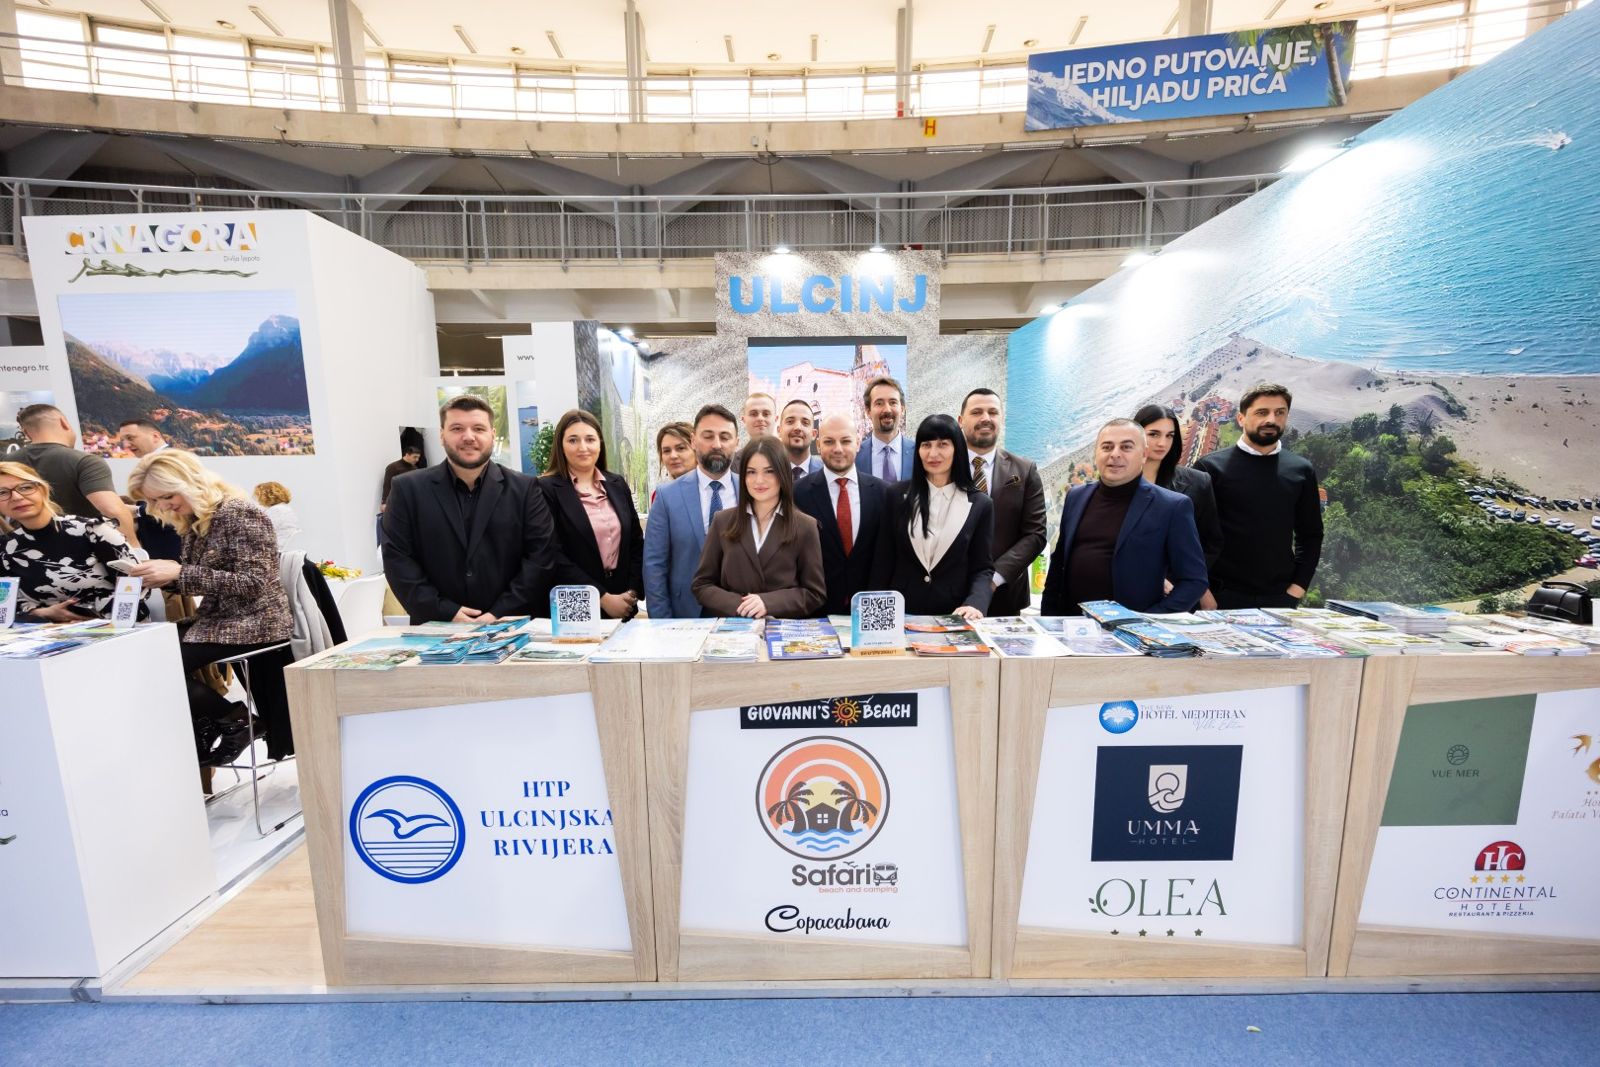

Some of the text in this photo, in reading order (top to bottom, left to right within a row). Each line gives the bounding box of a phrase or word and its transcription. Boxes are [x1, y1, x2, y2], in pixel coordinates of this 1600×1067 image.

[1063, 40, 1317, 86] JEDNO PUTOVANJE,
[1092, 67, 1288, 109] HILJADU PRIČA
[925, 119, 936, 135] H
[729, 274, 928, 314] ULCINJ
[747, 703, 911, 721] GIOVANNI'S BEACH
[1140, 708, 1247, 720] HOTEL MEDITERAN
[1432, 769, 1480, 778] VUE MER
[523, 780, 571, 798] HTP
[480, 809, 614, 831] ULCINJSKA
[1127, 820, 1201, 836] UMMA
[493, 838, 614, 859] RIVIJERA
[791, 863, 871, 886] Safari
[818, 886, 899, 895] beach and camping
[1093, 878, 1228, 917] OLEA
[1434, 886, 1557, 900] CONTINENTAL
[1461, 903, 1525, 911] HOTEL
[764, 904, 891, 934] Copacabana
